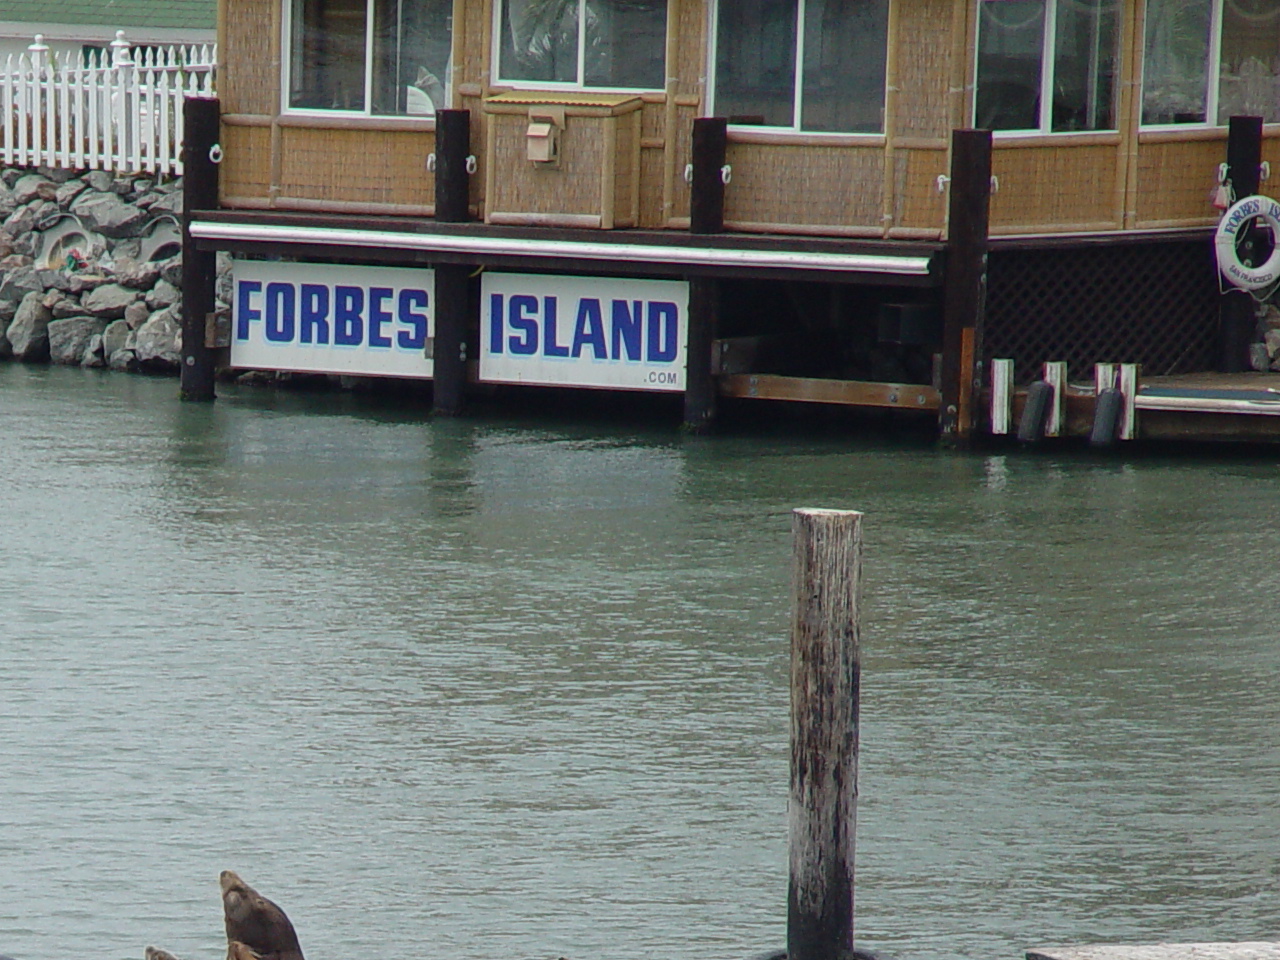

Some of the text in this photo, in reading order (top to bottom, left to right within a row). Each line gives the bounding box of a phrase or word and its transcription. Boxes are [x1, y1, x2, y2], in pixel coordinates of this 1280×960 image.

[1224, 199, 1260, 234] FORBES
[1229, 264, 1273, 283] SAN FRANCISCO
[237, 280, 678, 363] FORBES ISLAND
[643, 371, 677, 384] .COM
